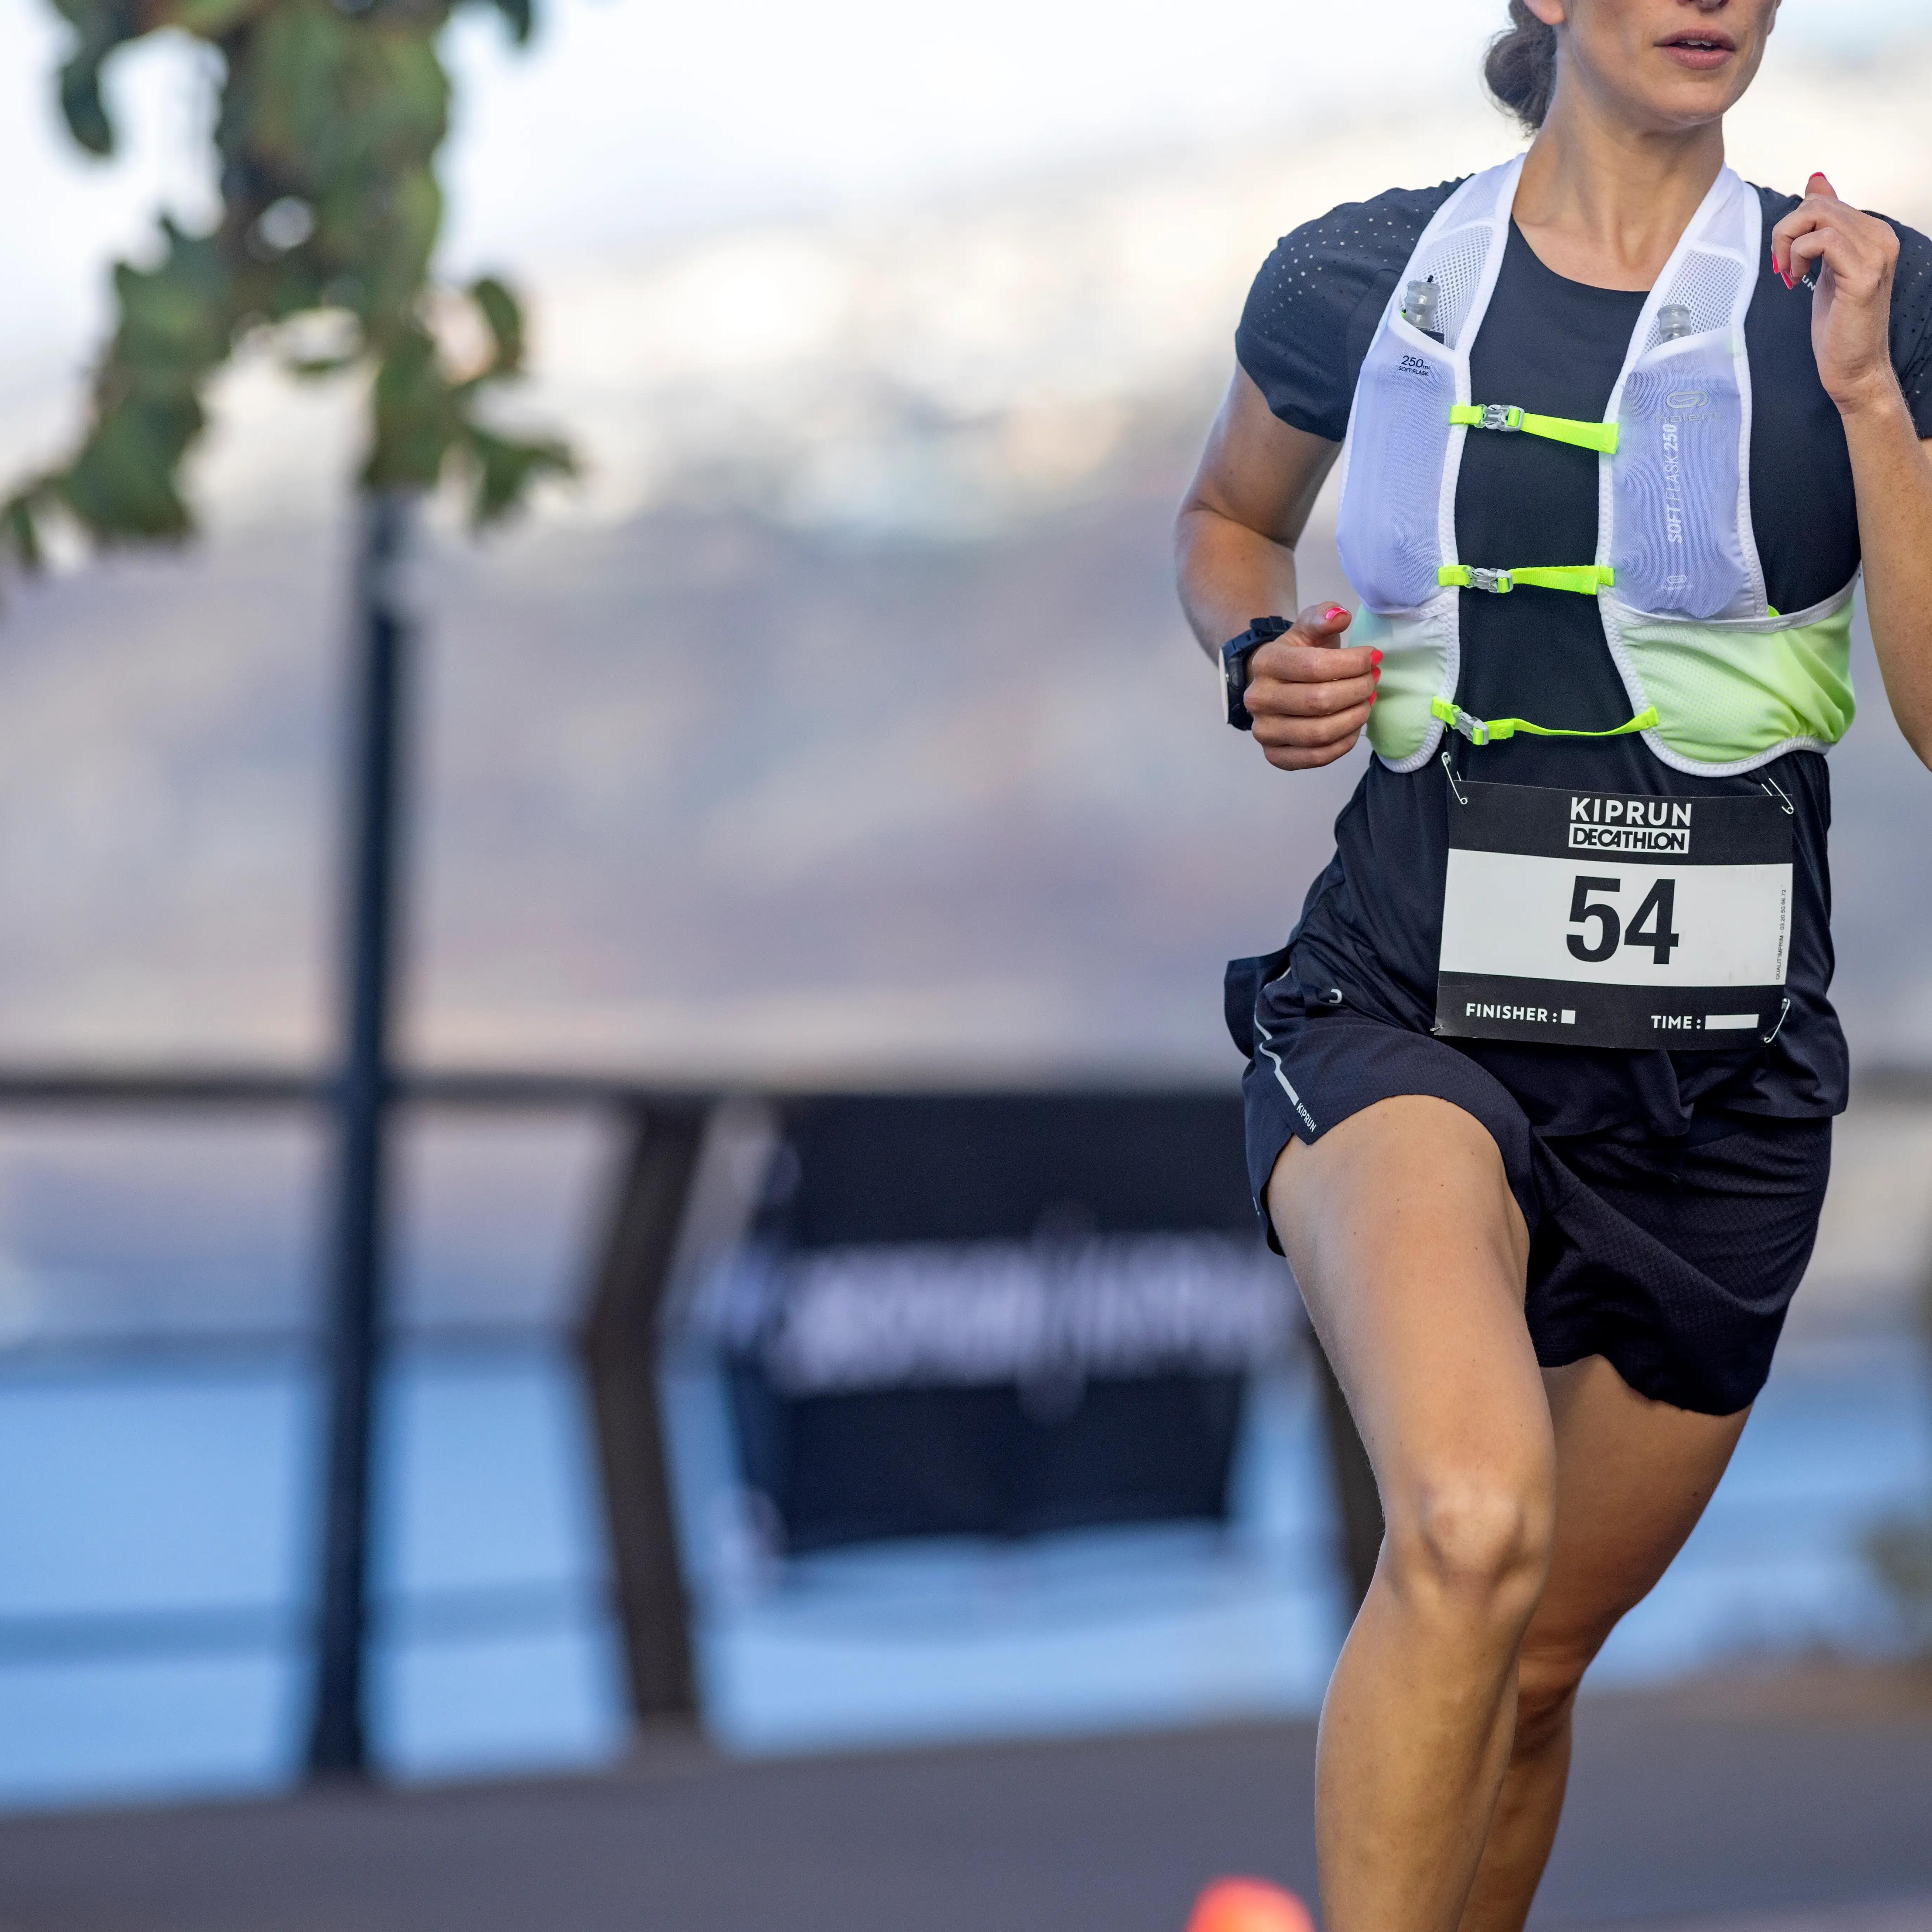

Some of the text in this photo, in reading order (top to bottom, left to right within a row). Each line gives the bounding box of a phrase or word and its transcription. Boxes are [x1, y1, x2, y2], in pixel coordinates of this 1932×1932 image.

[1663, 424, 1682, 543] SOFT FLASK 250
[1570, 797, 1692, 826] KIPRUN
[1572, 827, 1686, 850] DECATHLON
[1566, 875, 1679, 965] 54
[1296, 1102, 1317, 1132] KIPRUN
